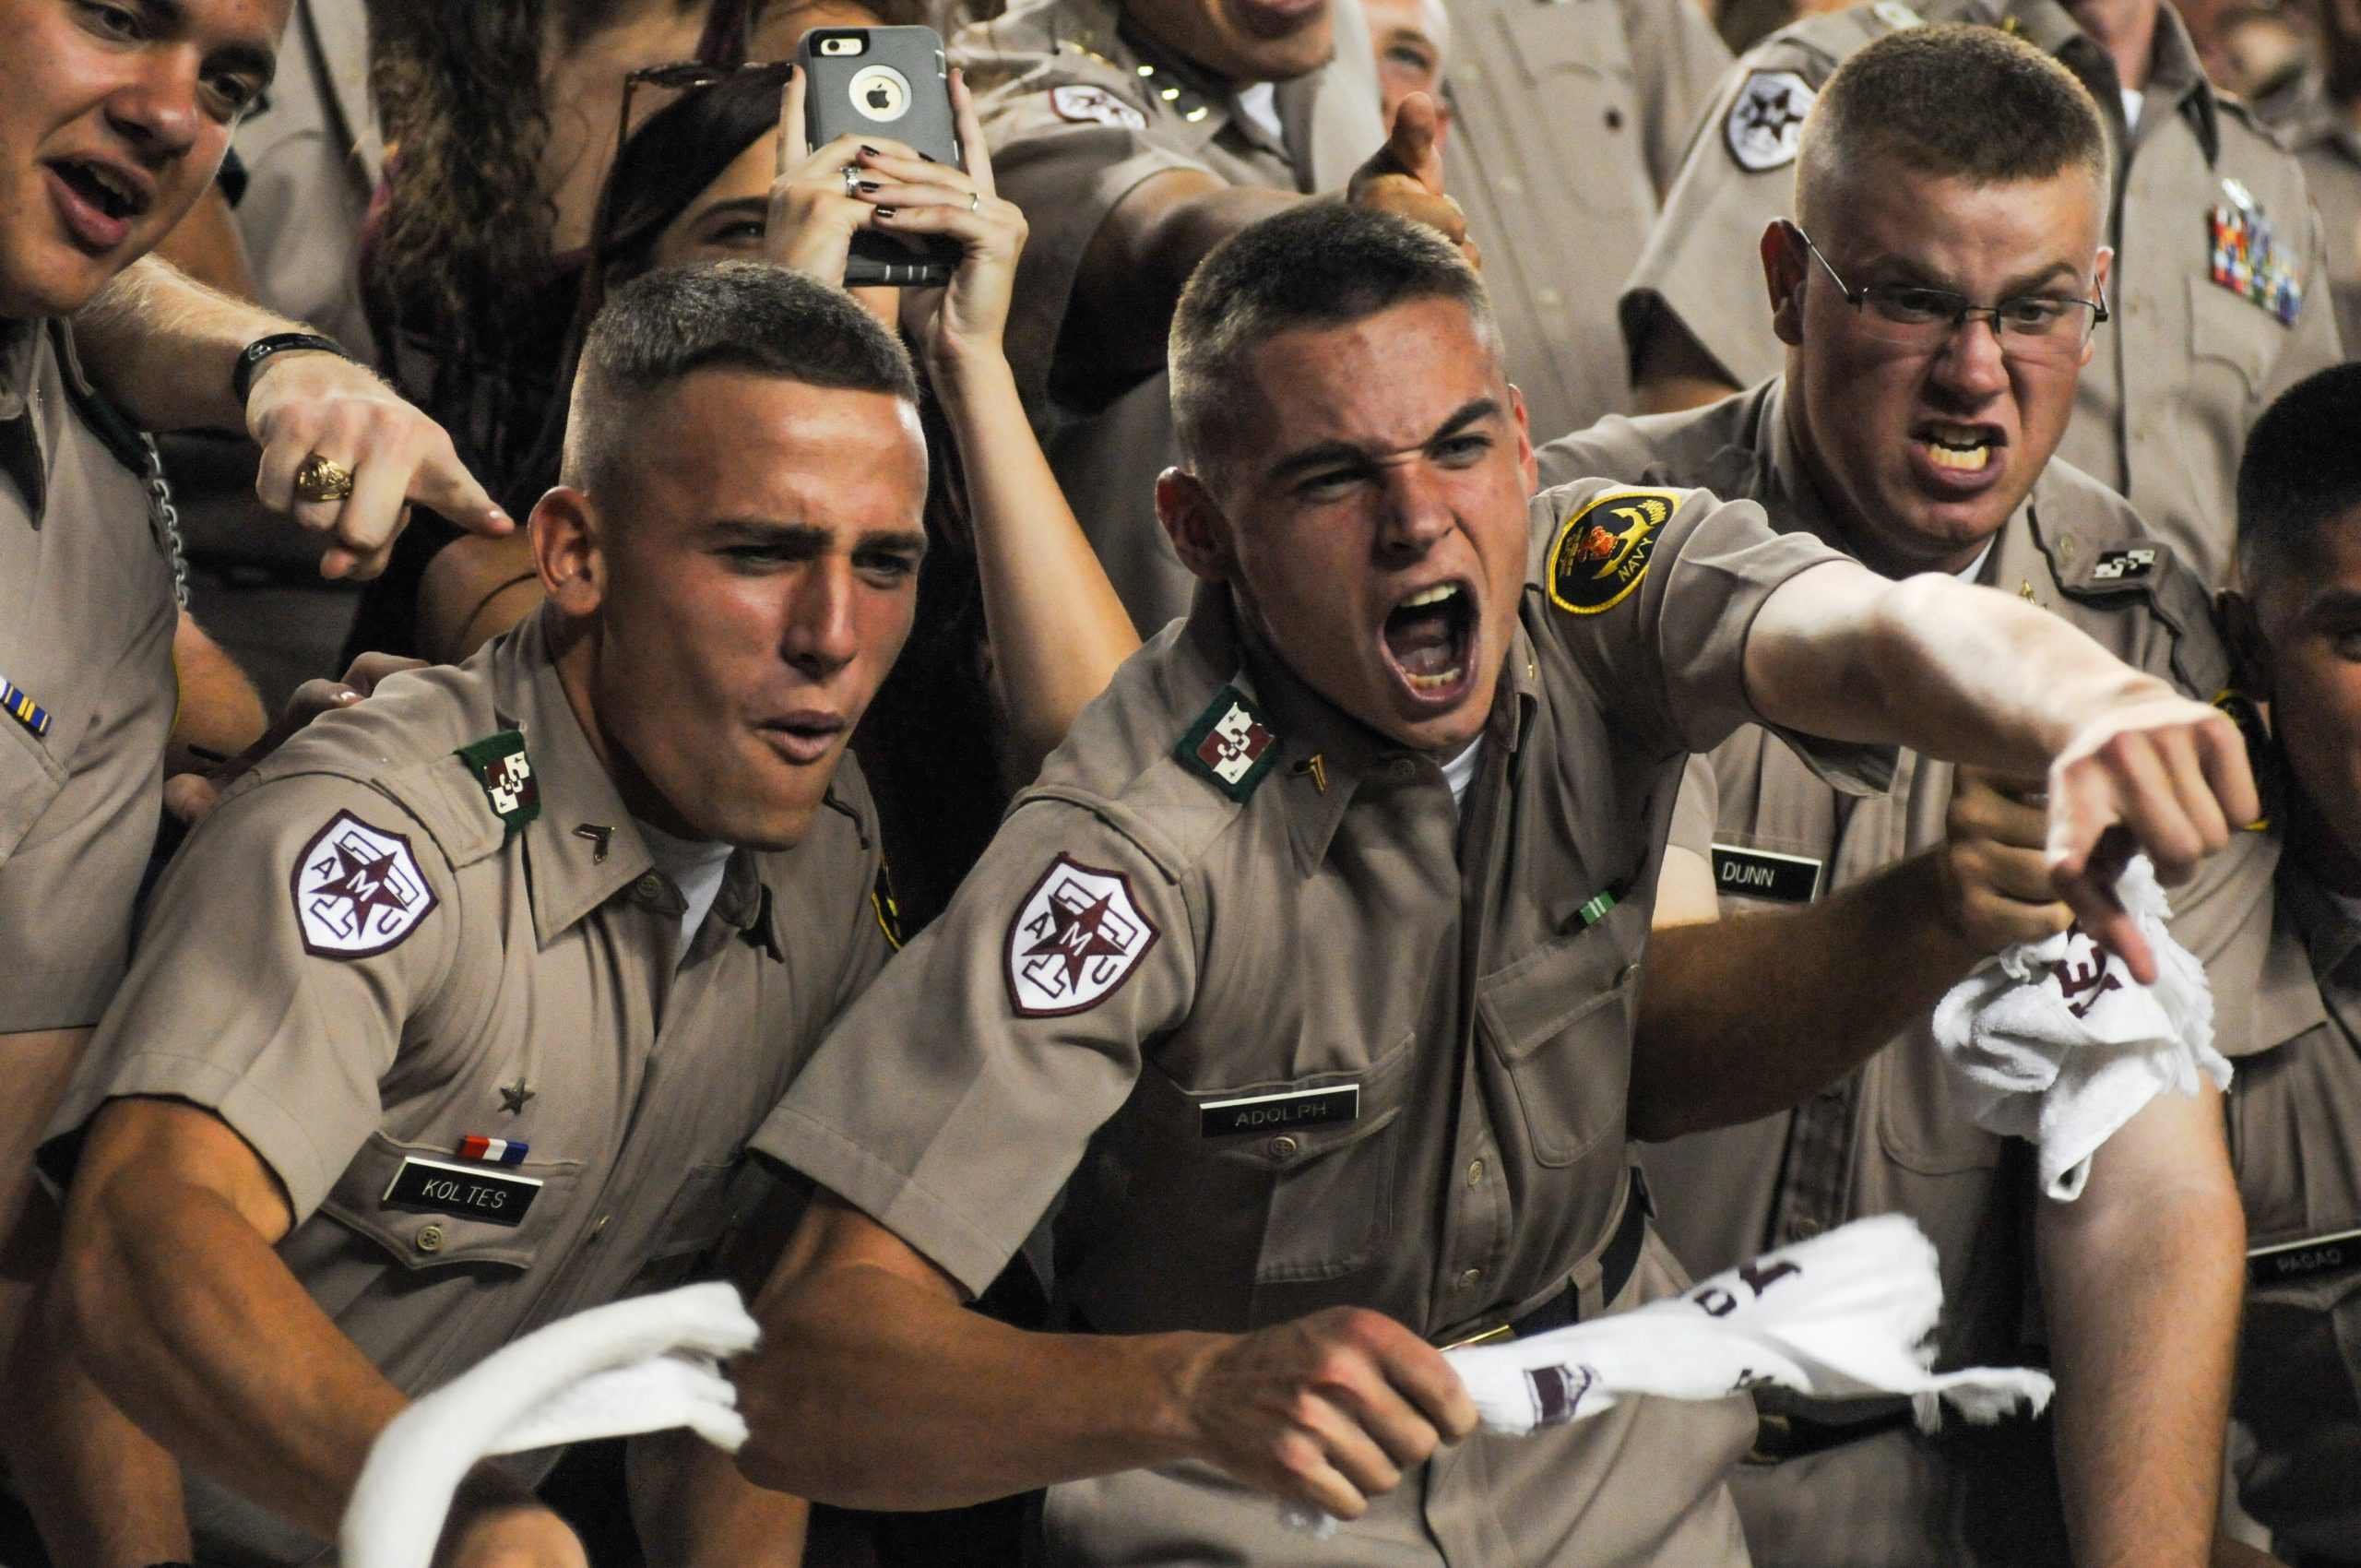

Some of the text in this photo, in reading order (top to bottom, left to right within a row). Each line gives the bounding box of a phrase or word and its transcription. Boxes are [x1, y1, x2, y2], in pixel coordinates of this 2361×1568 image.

[1618, 537, 1654, 583] NAVY
[1722, 861, 1775, 887] DUNN
[1234, 1101, 1326, 1127] ADOLPH
